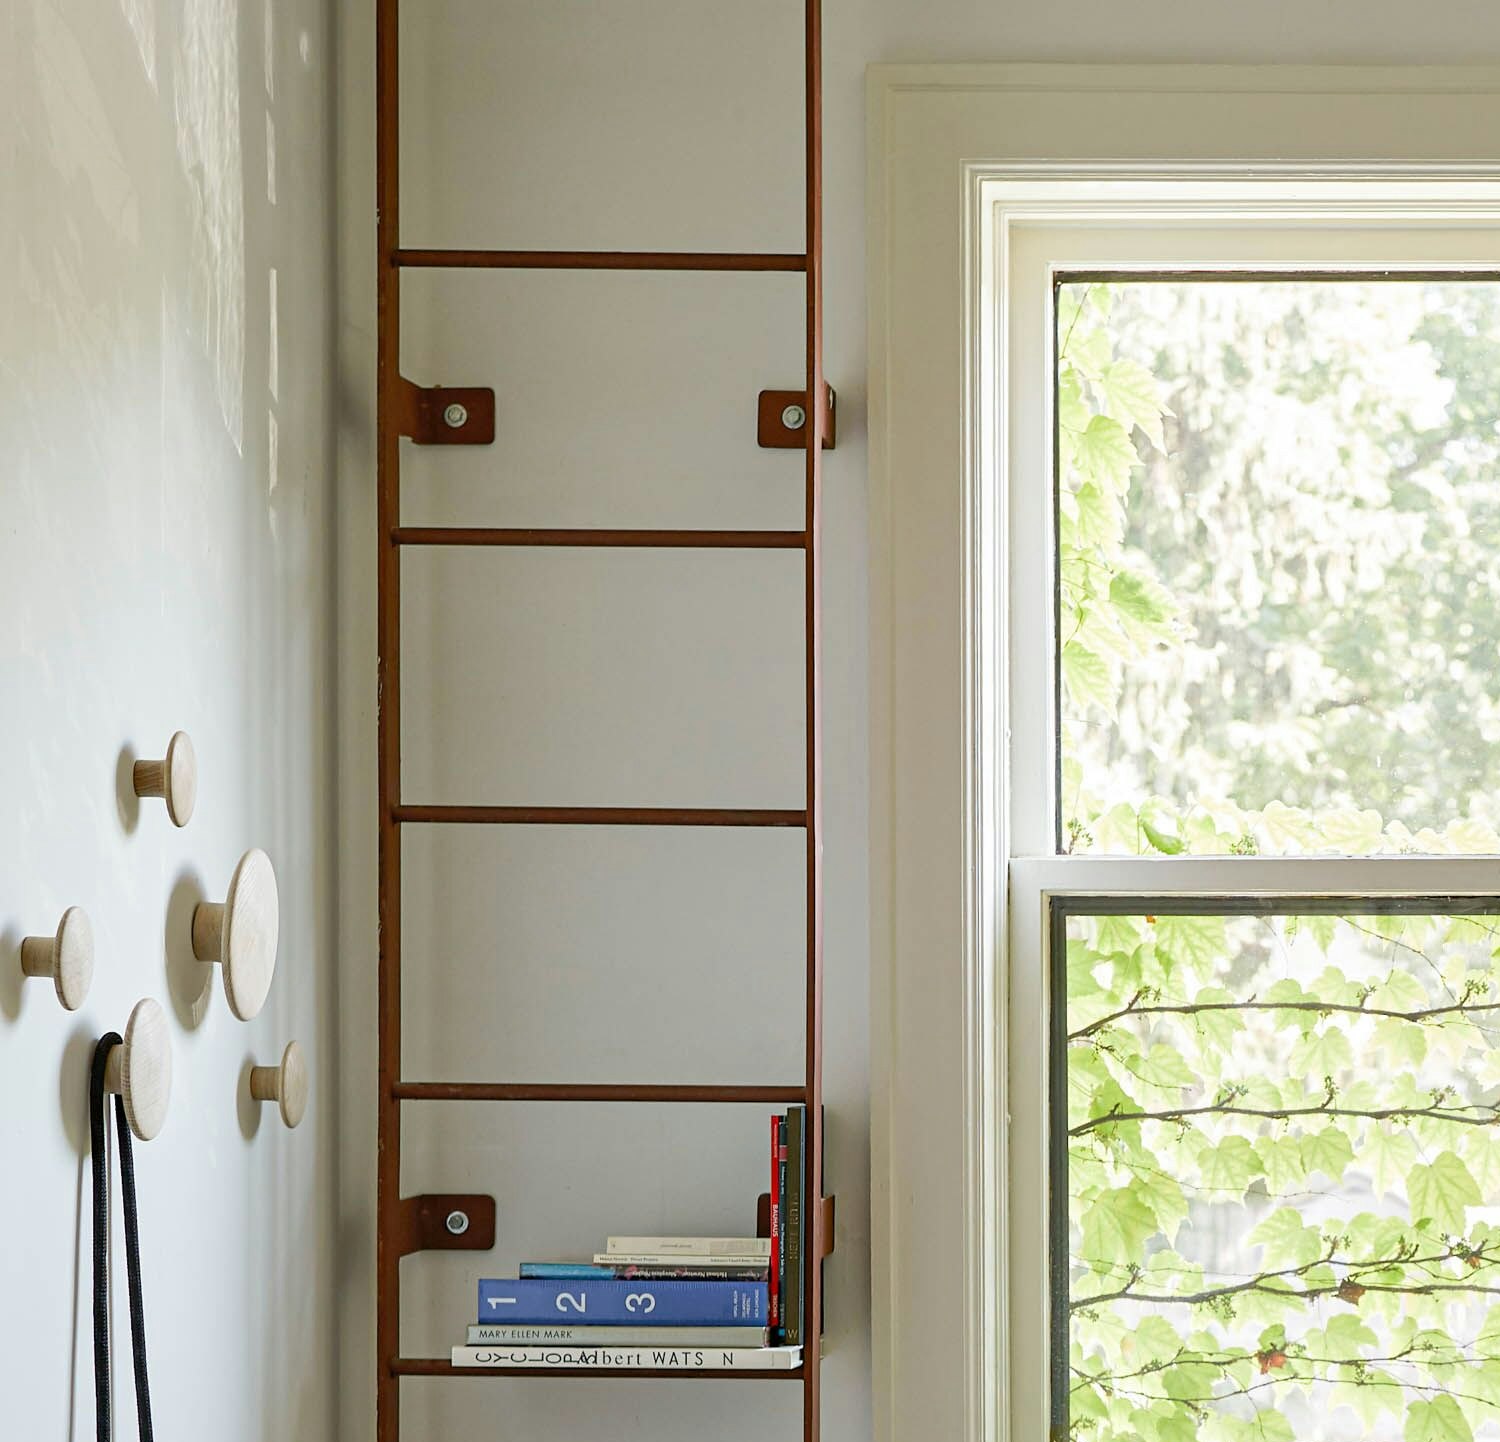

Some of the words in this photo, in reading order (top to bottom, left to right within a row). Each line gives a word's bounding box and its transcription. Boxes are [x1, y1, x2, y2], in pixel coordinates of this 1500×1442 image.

[487, 1297, 517, 1310] 1
[556, 1292, 586, 1313] 2
[625, 1292, 656, 1313] 3
[479, 1330, 507, 1339] MARY
[511, 1330, 540, 1339] ELLEN
[544, 1330, 573, 1339] MARK
